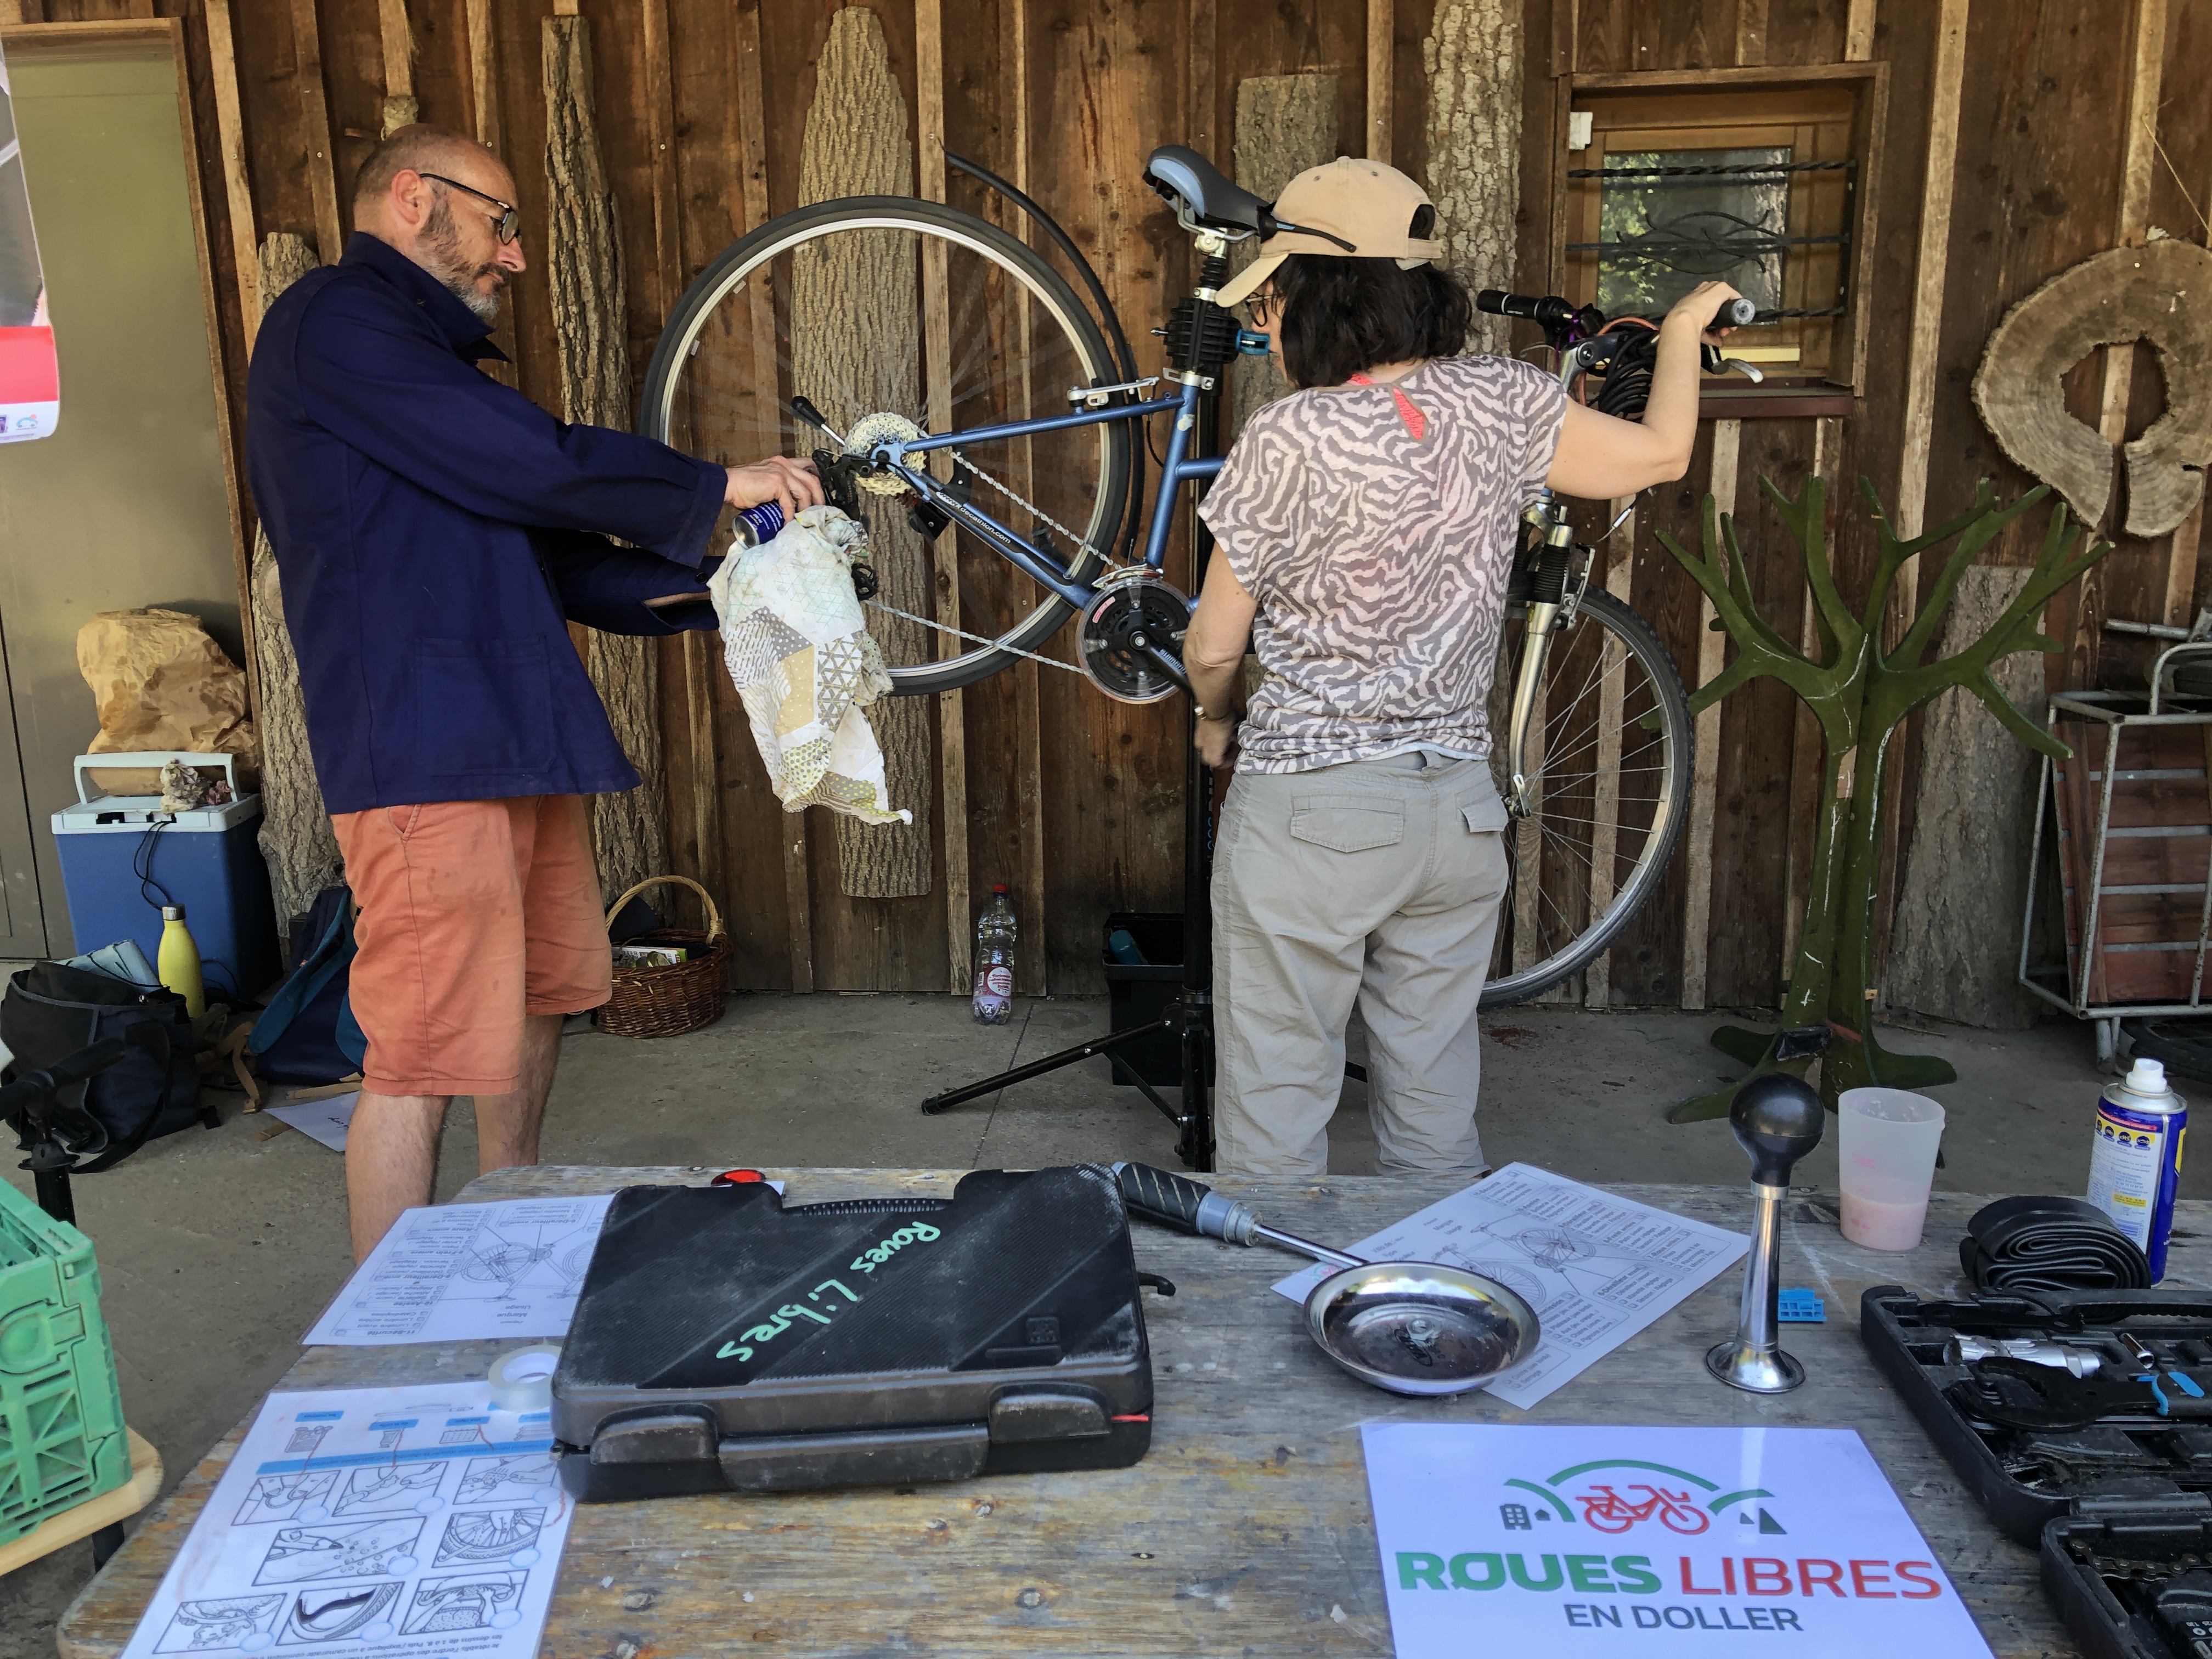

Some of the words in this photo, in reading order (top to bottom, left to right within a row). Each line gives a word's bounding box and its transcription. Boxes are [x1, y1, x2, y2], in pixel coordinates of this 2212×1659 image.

[1394, 1551, 1662, 1594] ROUES
[1680, 1555, 1942, 1600] LIBRES
[1564, 1603, 1623, 1629] EN
[1632, 1605, 1804, 1632] DOLLER
